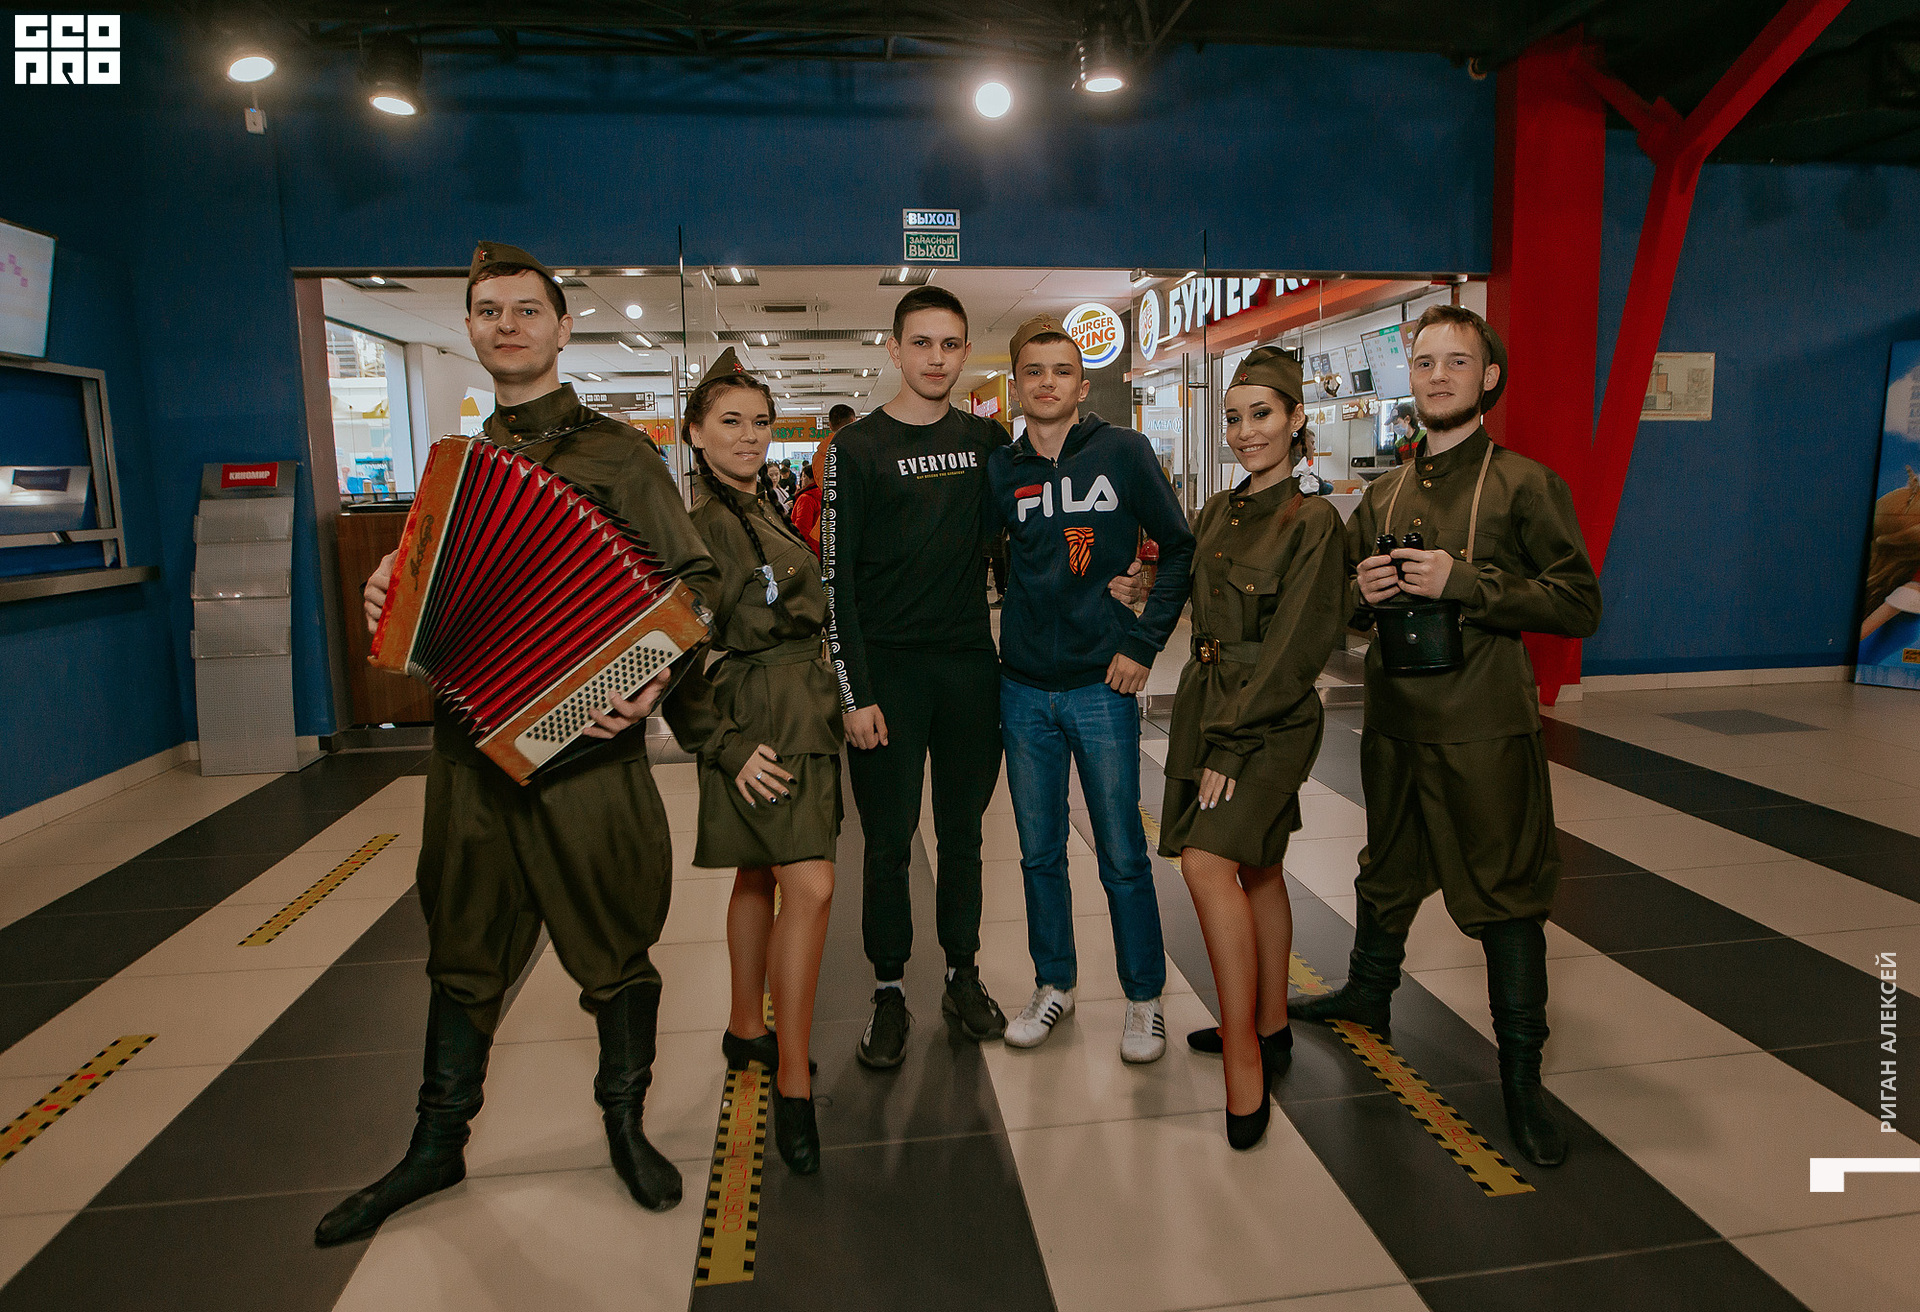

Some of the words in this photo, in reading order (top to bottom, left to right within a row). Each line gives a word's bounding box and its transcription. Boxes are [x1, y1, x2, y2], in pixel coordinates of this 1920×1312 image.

[908, 212, 955, 226] ВЫХОД
[909, 235, 955, 245] ЗАПАСНЫЙ
[909, 244, 955, 258] ВЫХОД
[1168, 277, 1261, 338] БУРГЕР
[1071, 316, 1114, 338] BURGER
[1073, 326, 1116, 350] KING
[229, 470, 270, 480] КИНОМИР
[897, 451, 978, 476] EVERYONE
[1014, 474, 1119, 522] FILA
[821, 507, 837, 580] STRONG
[1394, 1076, 1479, 1154] СОБЛЮДАЙТЕ
[721, 1140, 751, 1234] СОБЛЮДАЙТЕ
